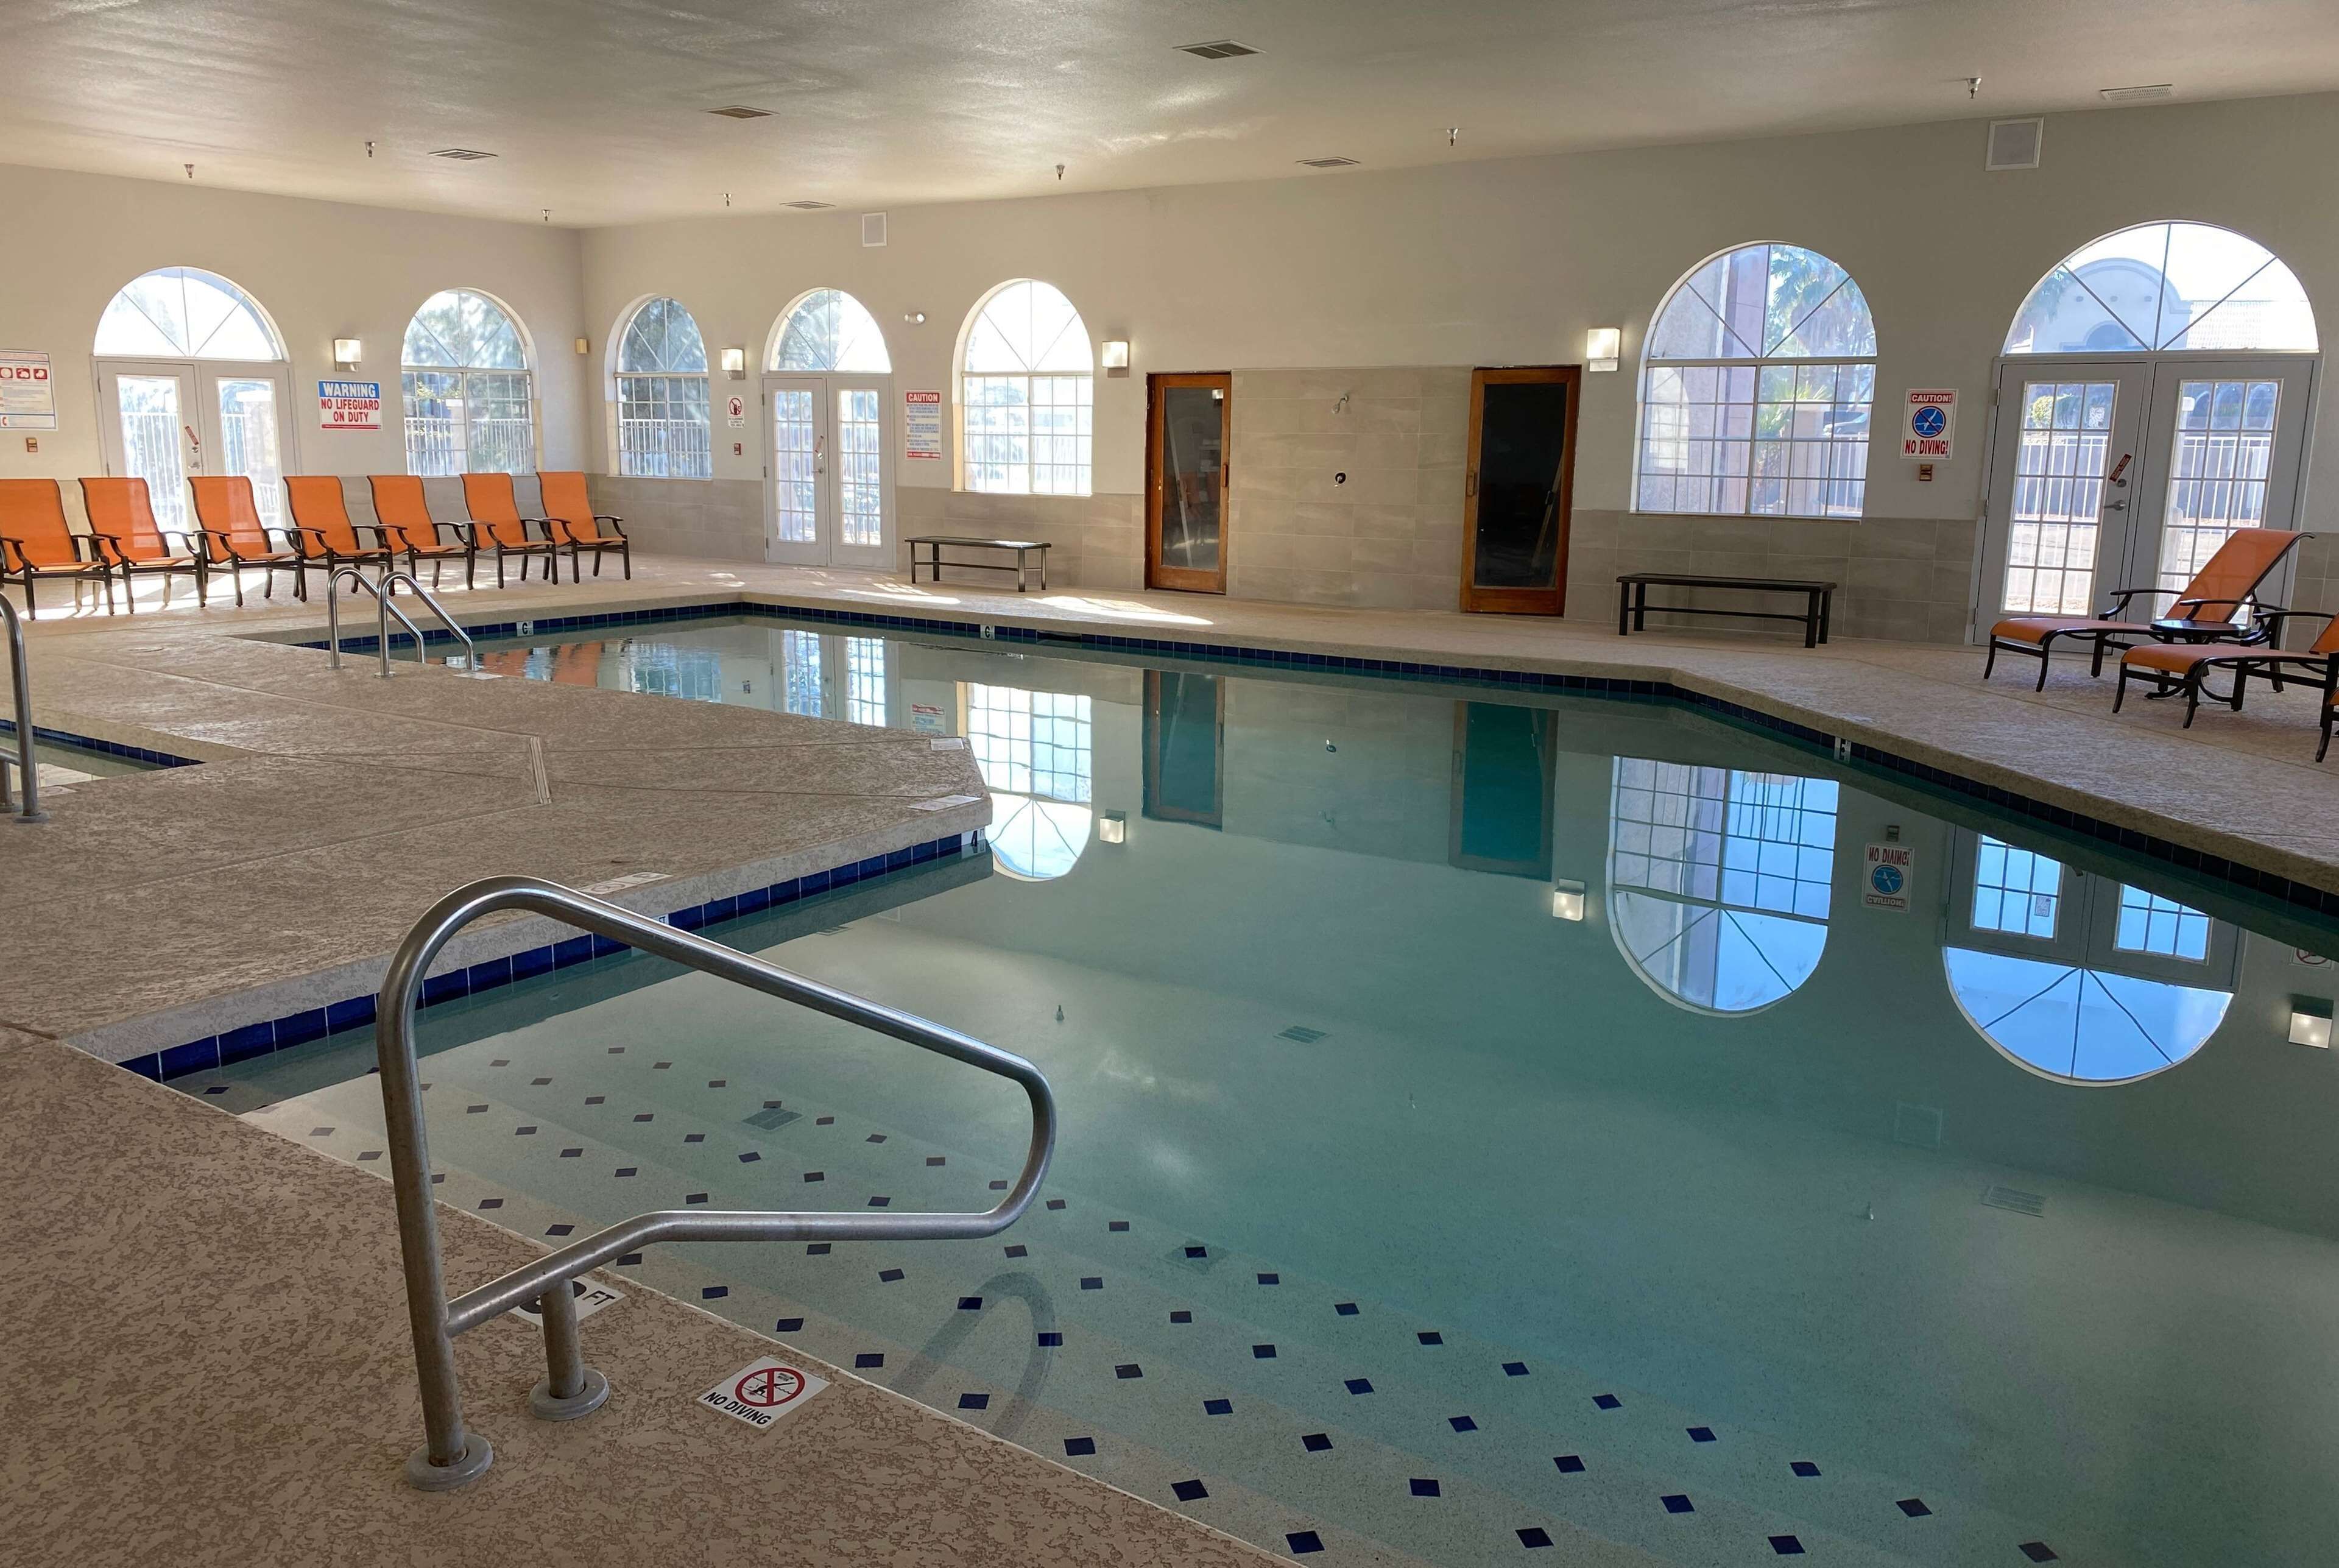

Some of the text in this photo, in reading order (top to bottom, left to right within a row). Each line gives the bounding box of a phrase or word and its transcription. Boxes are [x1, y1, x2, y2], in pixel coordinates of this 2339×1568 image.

[323, 383, 376, 398] WARNING
[321, 398, 379, 411] NO LIFEGUARD
[908, 394, 938, 402] CAUTION
[1911, 394, 1952, 403] CAUTION!
[333, 411, 369, 422] ON DUTY
[1905, 439, 1949, 455] NO DIVING!
[582, 1290, 616, 1305] FT
[704, 1391, 772, 1425] NO DIVING
